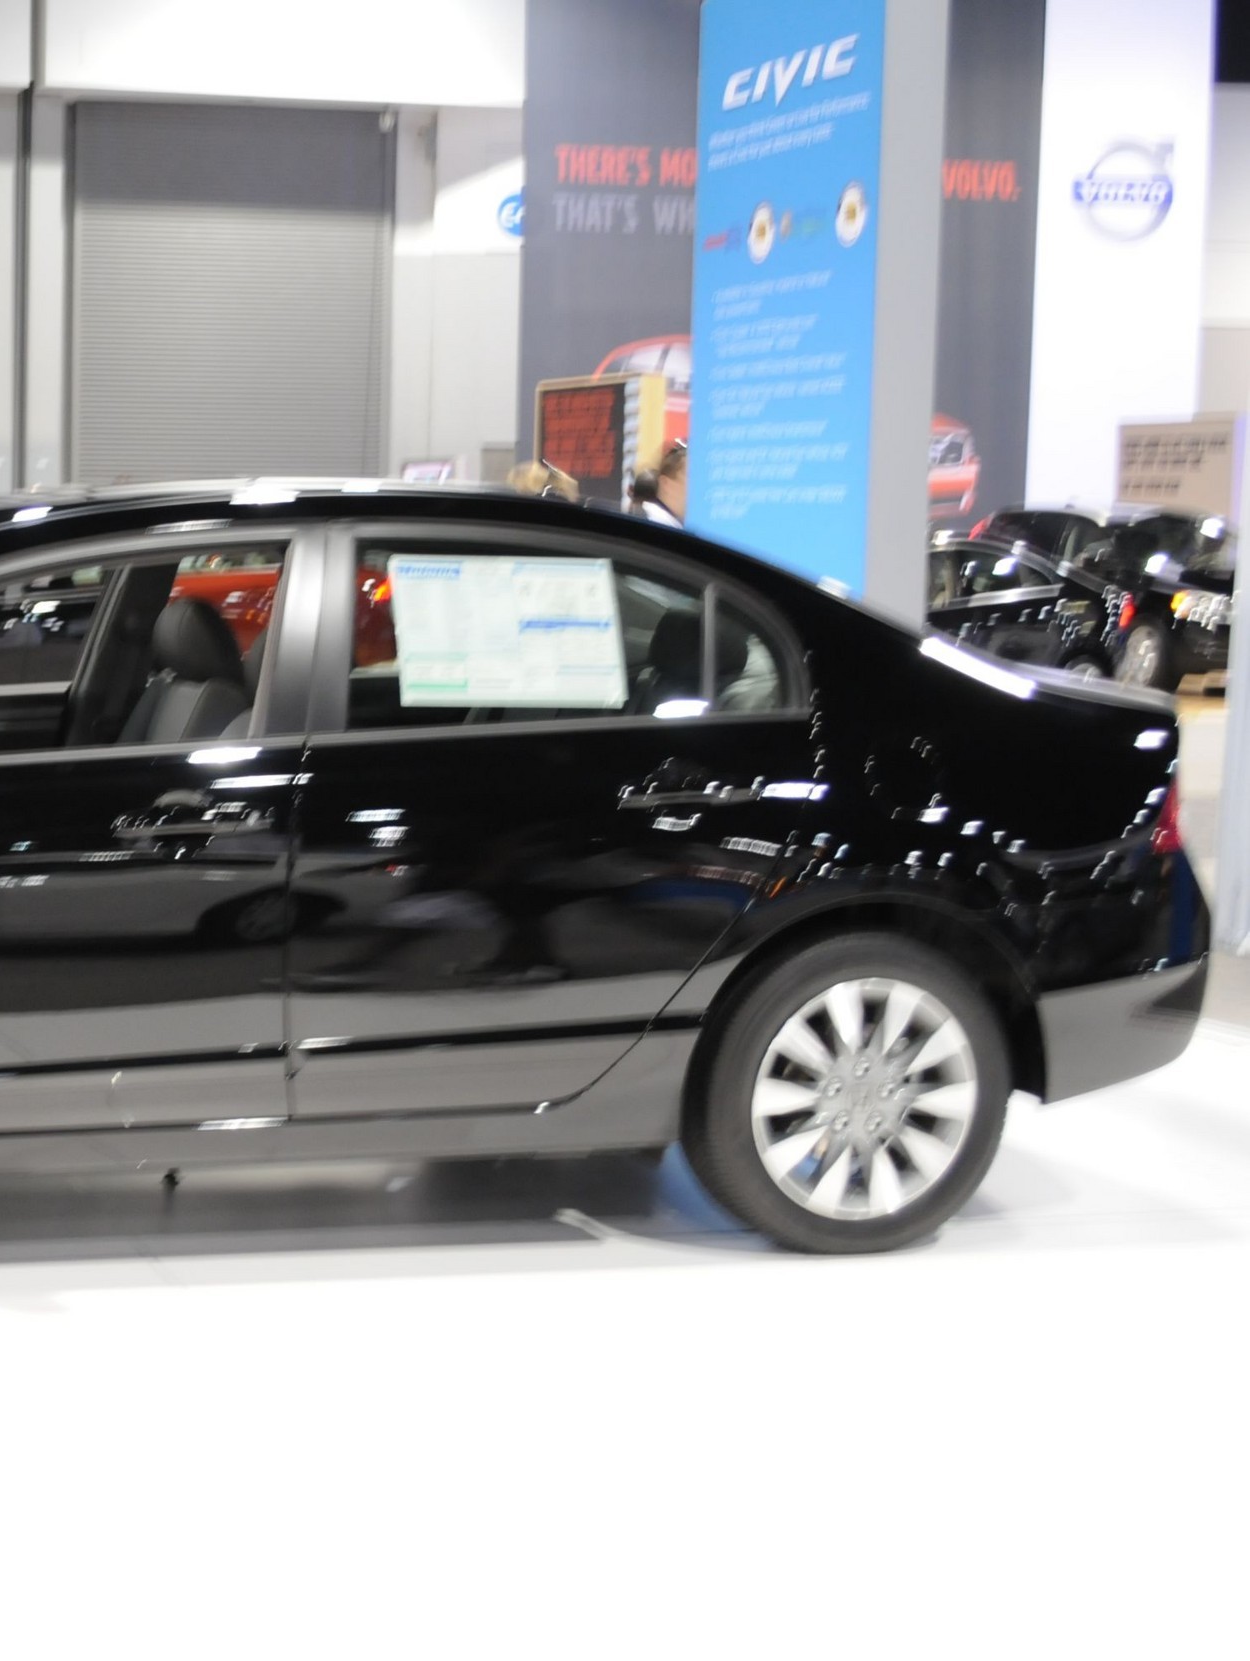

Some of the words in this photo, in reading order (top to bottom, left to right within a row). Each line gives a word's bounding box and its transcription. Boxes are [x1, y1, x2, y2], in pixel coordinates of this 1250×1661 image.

[722, 33, 860, 111] CIVIC
[554, 144, 651, 187] THERE'S
[552, 192, 639, 235] THAT'S
[1082, 181, 1168, 204] VOLVO
